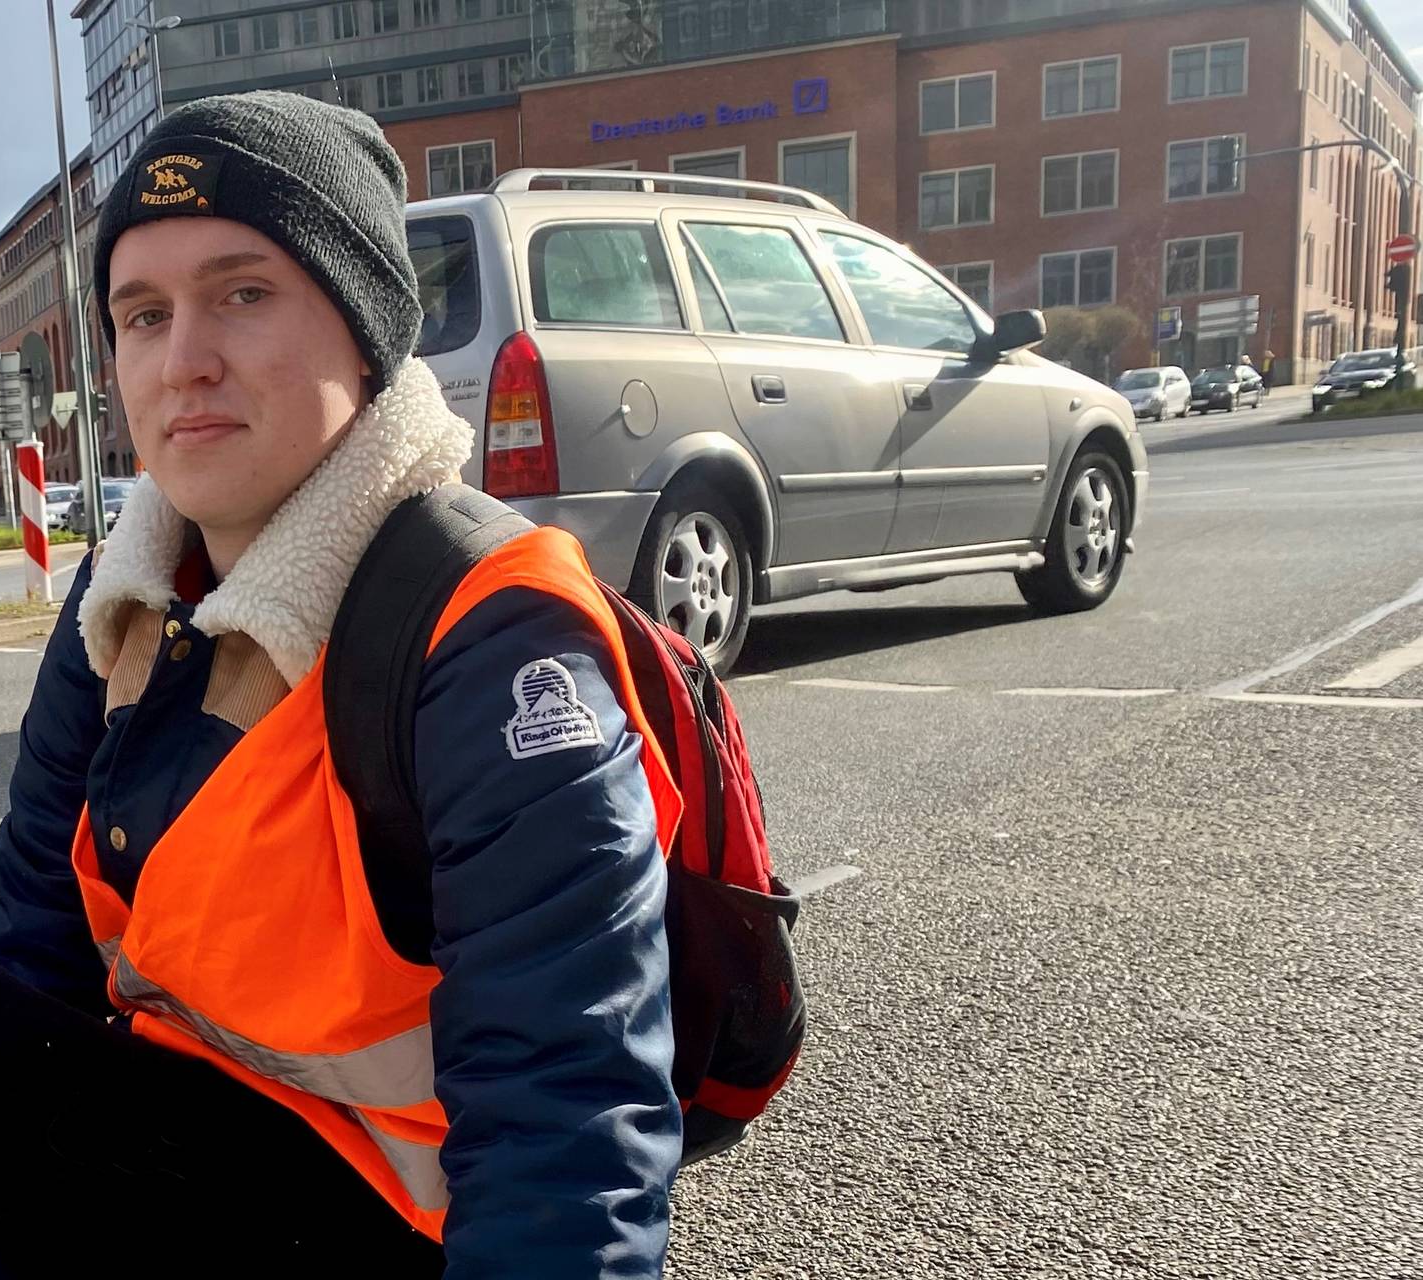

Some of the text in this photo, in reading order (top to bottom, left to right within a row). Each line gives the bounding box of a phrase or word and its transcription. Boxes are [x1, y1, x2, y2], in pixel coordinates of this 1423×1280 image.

[591, 101, 778, 142] Deutsche Bank
[146, 155, 203, 174] REFUGEES
[140, 187, 196, 205] WELCOME
[521, 731, 550, 743] Kings
[550, 725, 563, 736] Of
